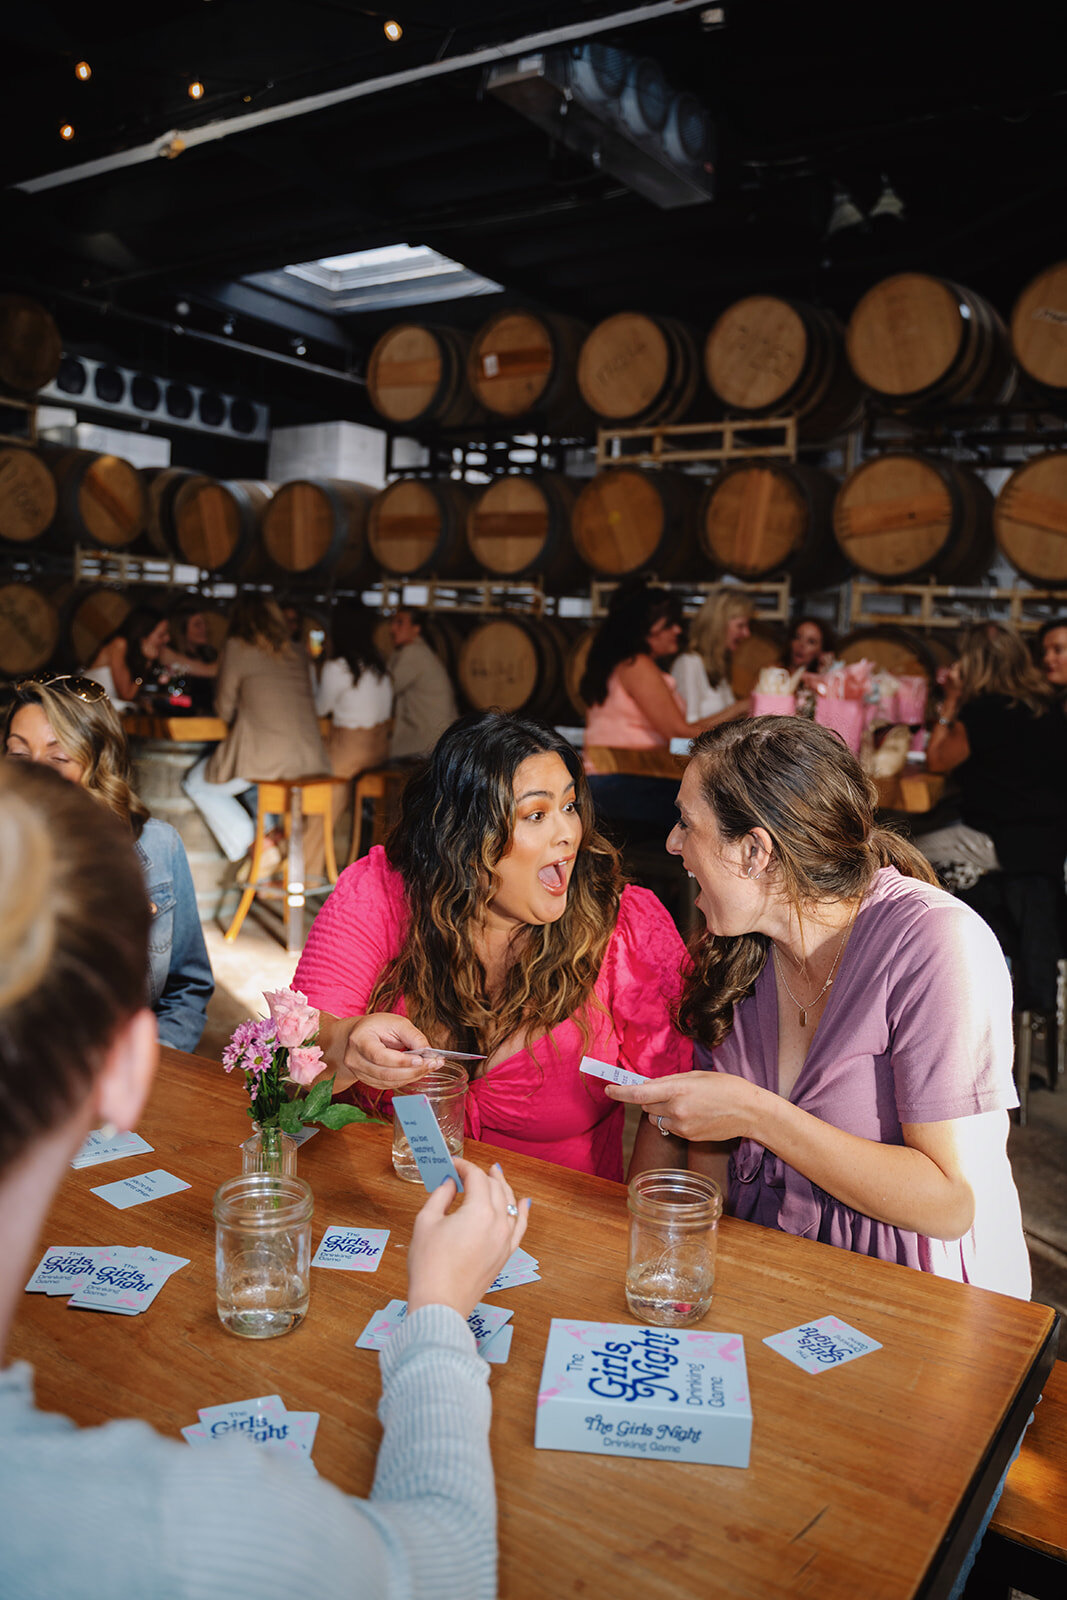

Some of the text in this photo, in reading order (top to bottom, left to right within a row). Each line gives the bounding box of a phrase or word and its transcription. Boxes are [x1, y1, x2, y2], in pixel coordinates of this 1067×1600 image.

[323, 1242, 380, 1256] Night
[325, 1235, 370, 1246] Girls
[41, 1262, 96, 1276] Nigh
[44, 1256, 94, 1267] Girls
[92, 1273, 155, 1292] Night
[97, 1266, 146, 1281] Girls
[86, 1285, 121, 1294] Drinking
[797, 1338, 838, 1364] Girls
[798, 1327, 853, 1360] Night
[833, 1334, 861, 1353] Drinking
[848, 1337, 868, 1350] Game
[566, 1353, 584, 1372] The
[796, 1349, 809, 1360] The
[588, 1342, 637, 1402] Girls
[631, 1329, 680, 1402] Night
[686, 1362, 704, 1406] Drinking
[708, 1376, 725, 1408] Game
[210, 1416, 268, 1436] Girls
[584, 1414, 702, 1444] The Girls Night
[603, 1436, 681, 1454] Drinking Game
